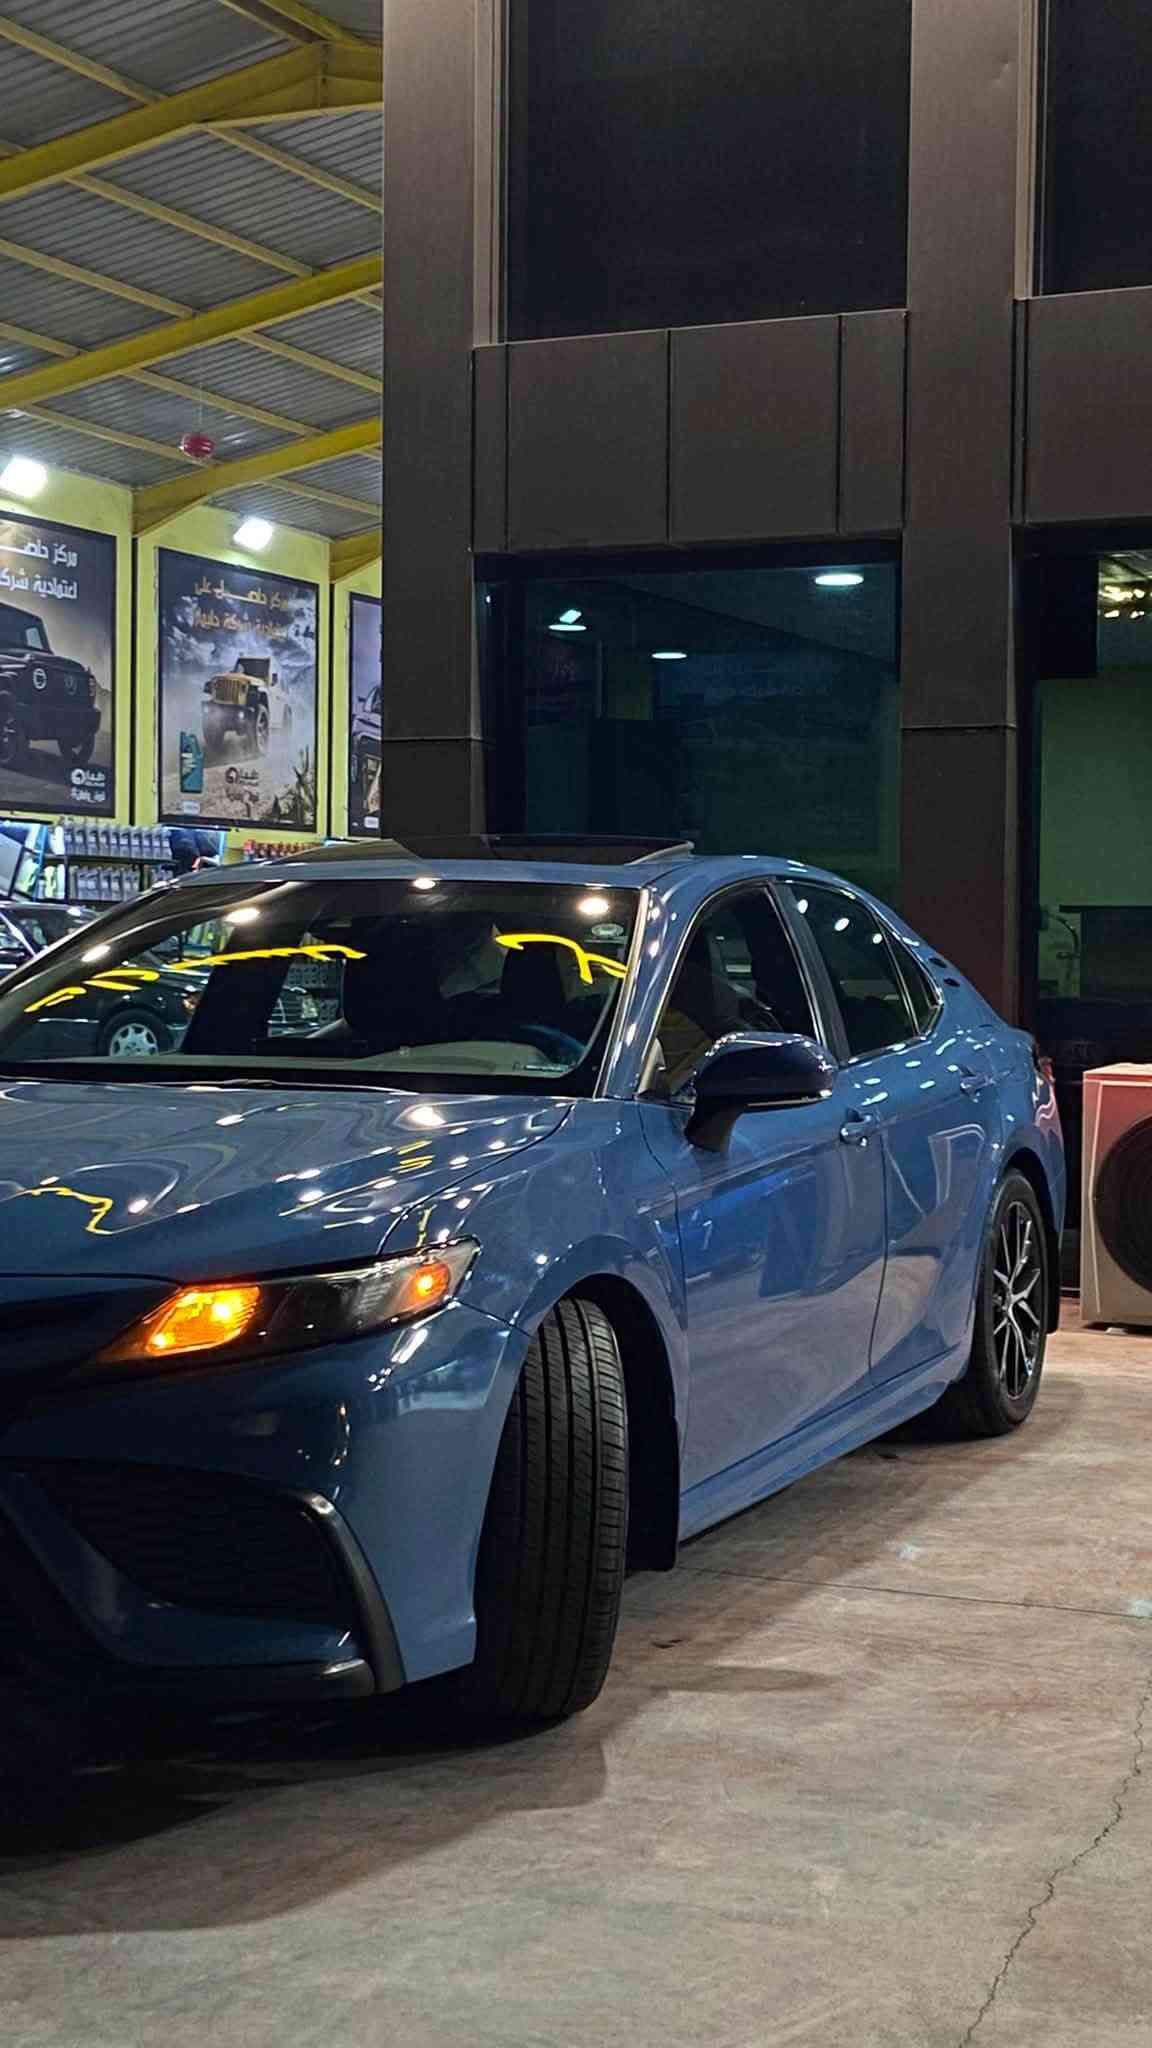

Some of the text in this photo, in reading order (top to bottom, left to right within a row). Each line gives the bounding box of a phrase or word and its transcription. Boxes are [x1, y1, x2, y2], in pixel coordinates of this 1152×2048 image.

[0, 539, 78, 567] مركز حاص
[0, 567, 78, 599] اعتمادية شرك
